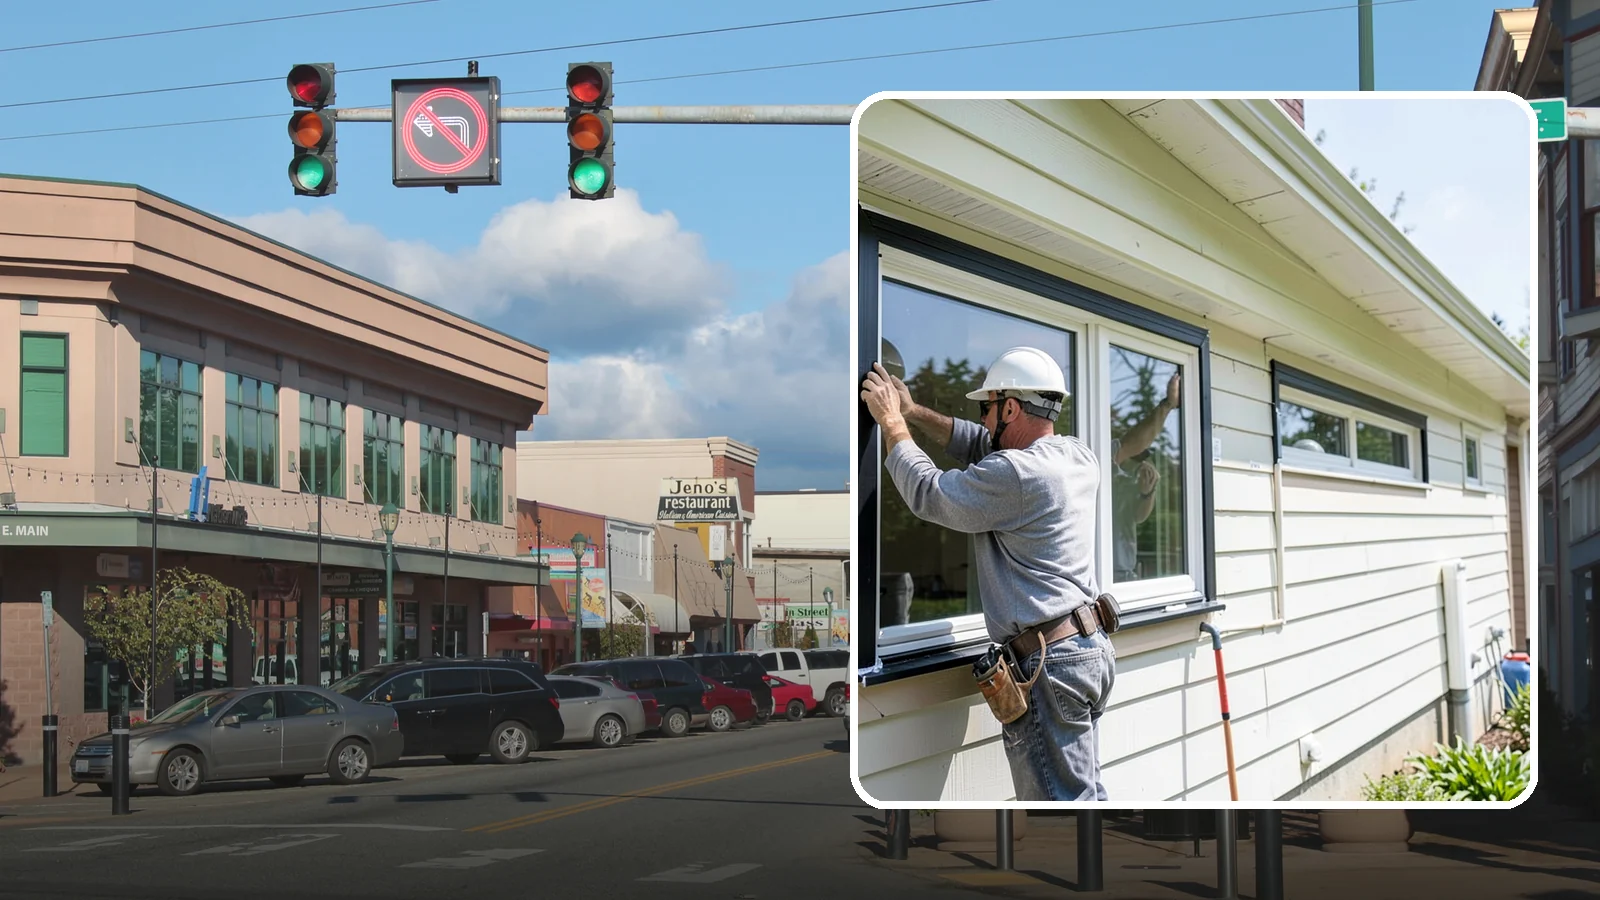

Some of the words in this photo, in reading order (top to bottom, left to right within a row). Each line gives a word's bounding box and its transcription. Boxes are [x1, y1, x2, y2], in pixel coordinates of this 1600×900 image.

[669, 480, 727, 494] Jeno's
[665, 496, 731, 508] restaurant
[659, 510, 681, 519] Italian
[686, 509, 714, 519] American
[715, 509, 737, 519] Cuisine
[2, 525, 13, 536] E.
[15, 525, 49, 536] MAIN
[797, 607, 829, 617] Street
